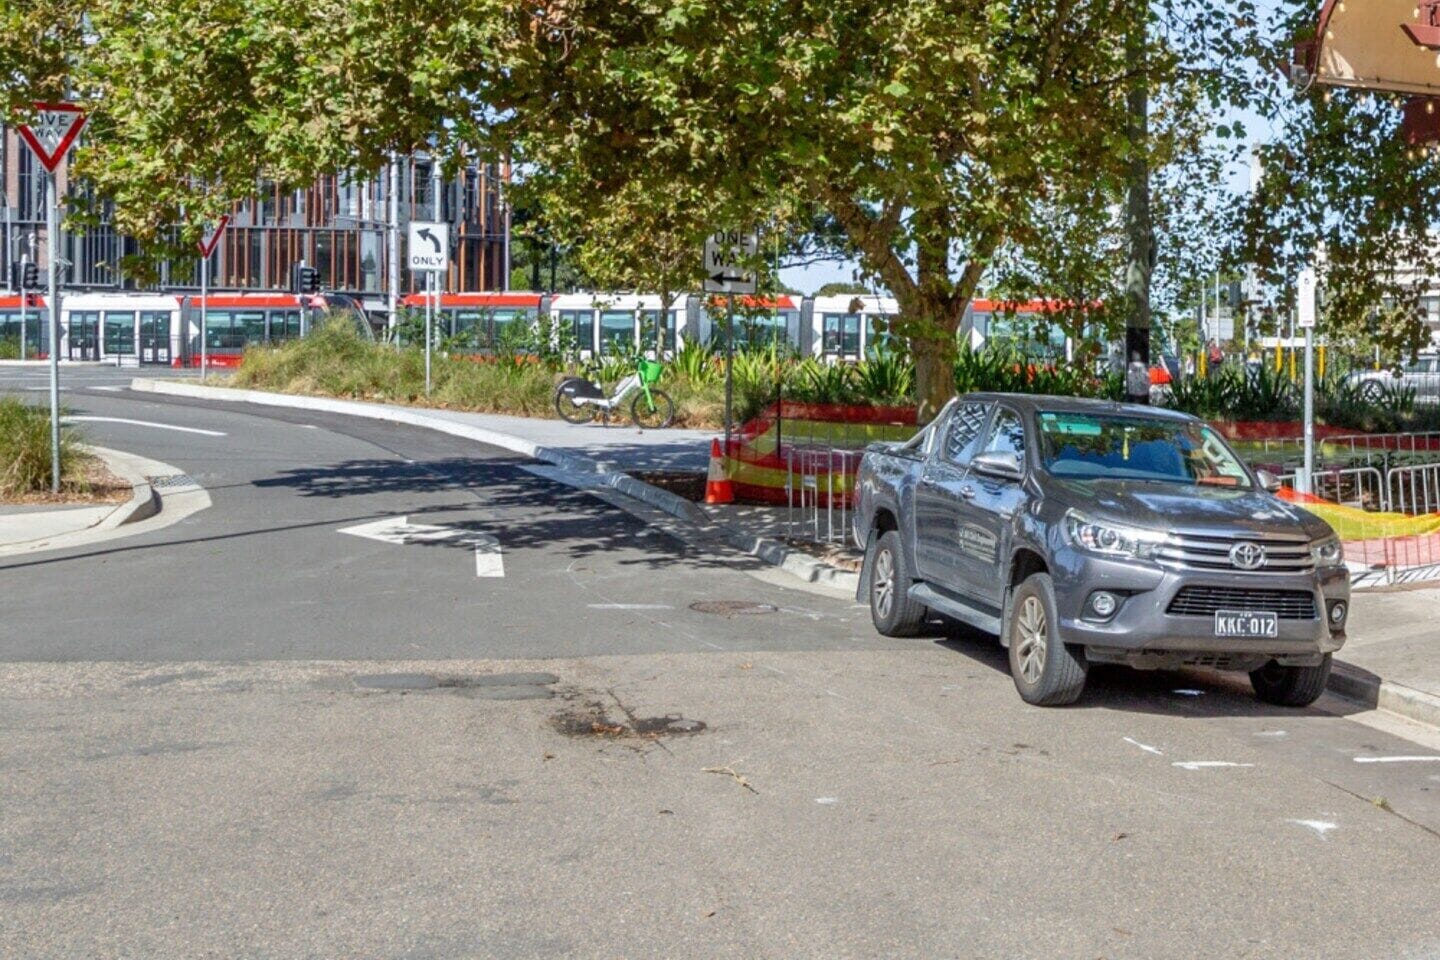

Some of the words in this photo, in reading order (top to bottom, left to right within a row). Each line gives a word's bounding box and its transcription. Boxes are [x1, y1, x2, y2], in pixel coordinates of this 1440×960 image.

[39, 114, 68, 126] IVE
[35, 128, 62, 138] WAY
[714, 230, 749, 246] ONE
[412, 256, 443, 265] ONLY
